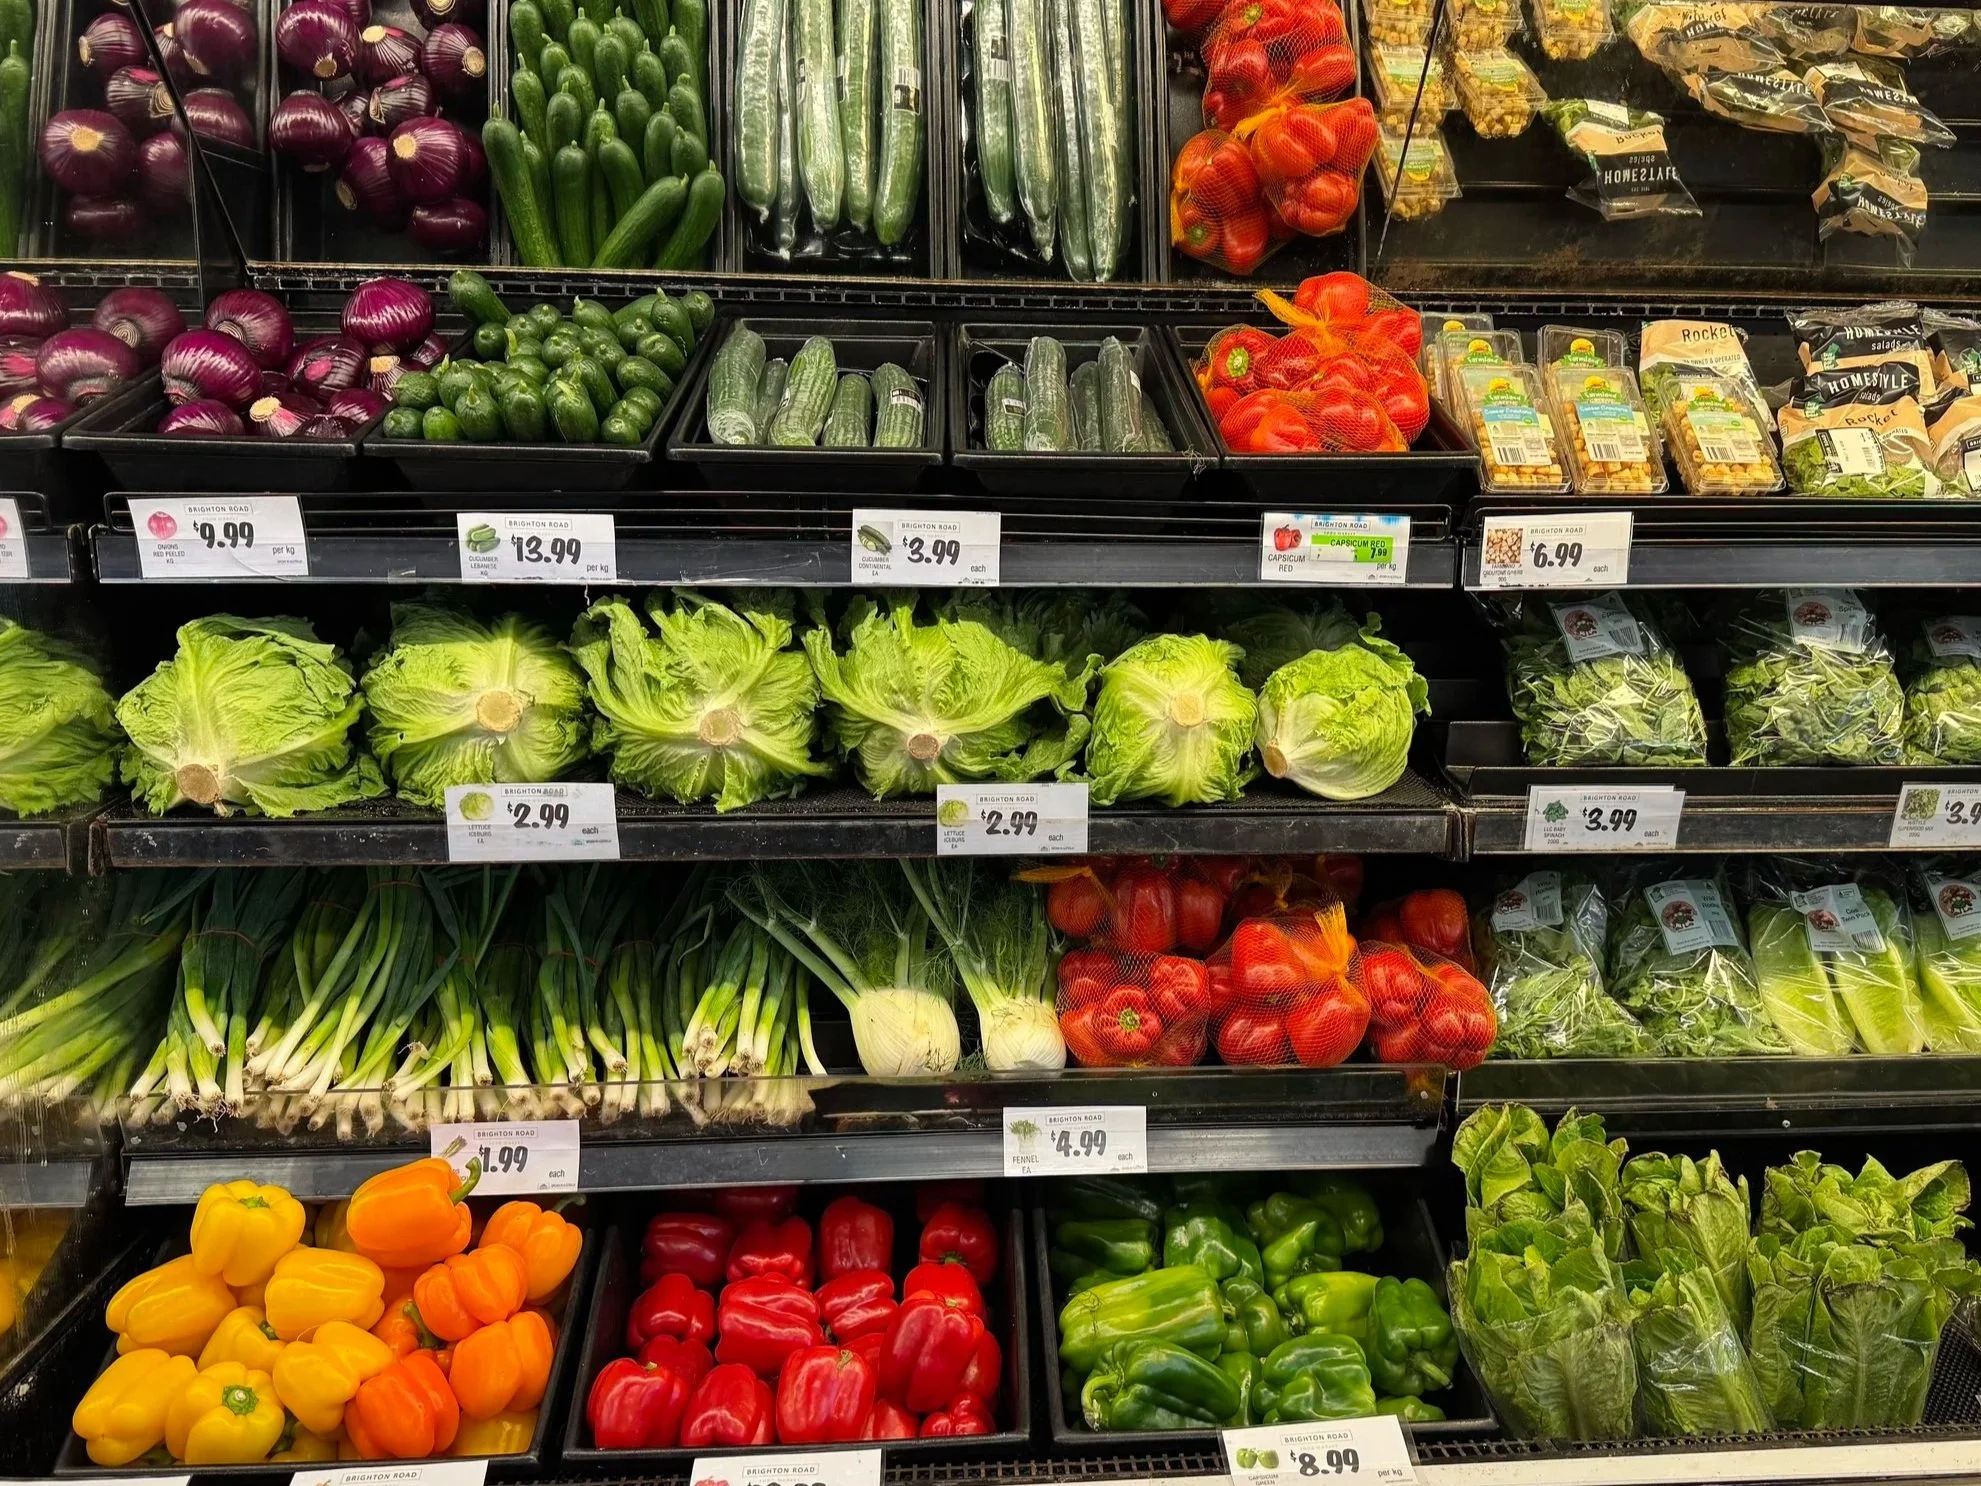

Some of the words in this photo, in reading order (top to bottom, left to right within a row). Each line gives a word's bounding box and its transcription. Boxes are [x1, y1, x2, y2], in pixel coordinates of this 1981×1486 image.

[1681, 325, 1735, 342] Rocket
[1871, 339, 1901, 350] salads
[1844, 408, 1899, 427] Rocket
[901, 522, 936, 530] BRIGHTON
[938, 523, 957, 531] ROAD
[193, 519, 254, 549] $9.99
[1330, 538, 1369, 547] CAPSICUM
[1370, 540, 1386, 548] RED
[272, 546, 285, 556] per
[285, 545, 295, 555] kg
[511, 533, 581, 565] $13.99
[902, 536, 960, 566] $3.99
[1371, 547, 1388, 560] 7.99
[1268, 553, 1306, 563] CAPSICUM
[1530, 541, 1583, 568] $6.99
[586, 564, 599, 572] per
[600, 563, 609, 573] kg
[970, 564, 986, 573] each
[1278, 564, 1293, 572] RED
[1388, 562, 1397, 571] kg
[1593, 565, 1609, 573] each
[507, 801, 569, 830] $2.99
[1582, 807, 1638, 832] $3.99
[980, 809, 1038, 836] $2.99
[582, 827, 599, 835] each
[1048, 834, 1064, 842] each
[1050, 1130, 1107, 1157] $4.99
[479, 1144, 528, 1173] $1.99
[1012, 1154, 1039, 1164] FENNEL
[1118, 1152, 1133, 1161] each
[549, 1169, 565, 1178] each
[1022, 1166, 1032, 1174] EA
[1284, 1435, 1324, 1443] BRIGHTON
[1327, 1432, 1349, 1440] ROAD
[1289, 1448, 1360, 1477] $8.99
[746, 1467, 789, 1475] BRIGHTON
[792, 1466, 815, 1474] ROAD
[1378, 1470, 1391, 1478] per
[1393, 1468, 1403, 1477] kg
[345, 1473, 391, 1482] BRIGHTON
[393, 1471, 417, 1479] ROAD
[1248, 1473, 1279, 1481] CAPSICUM
